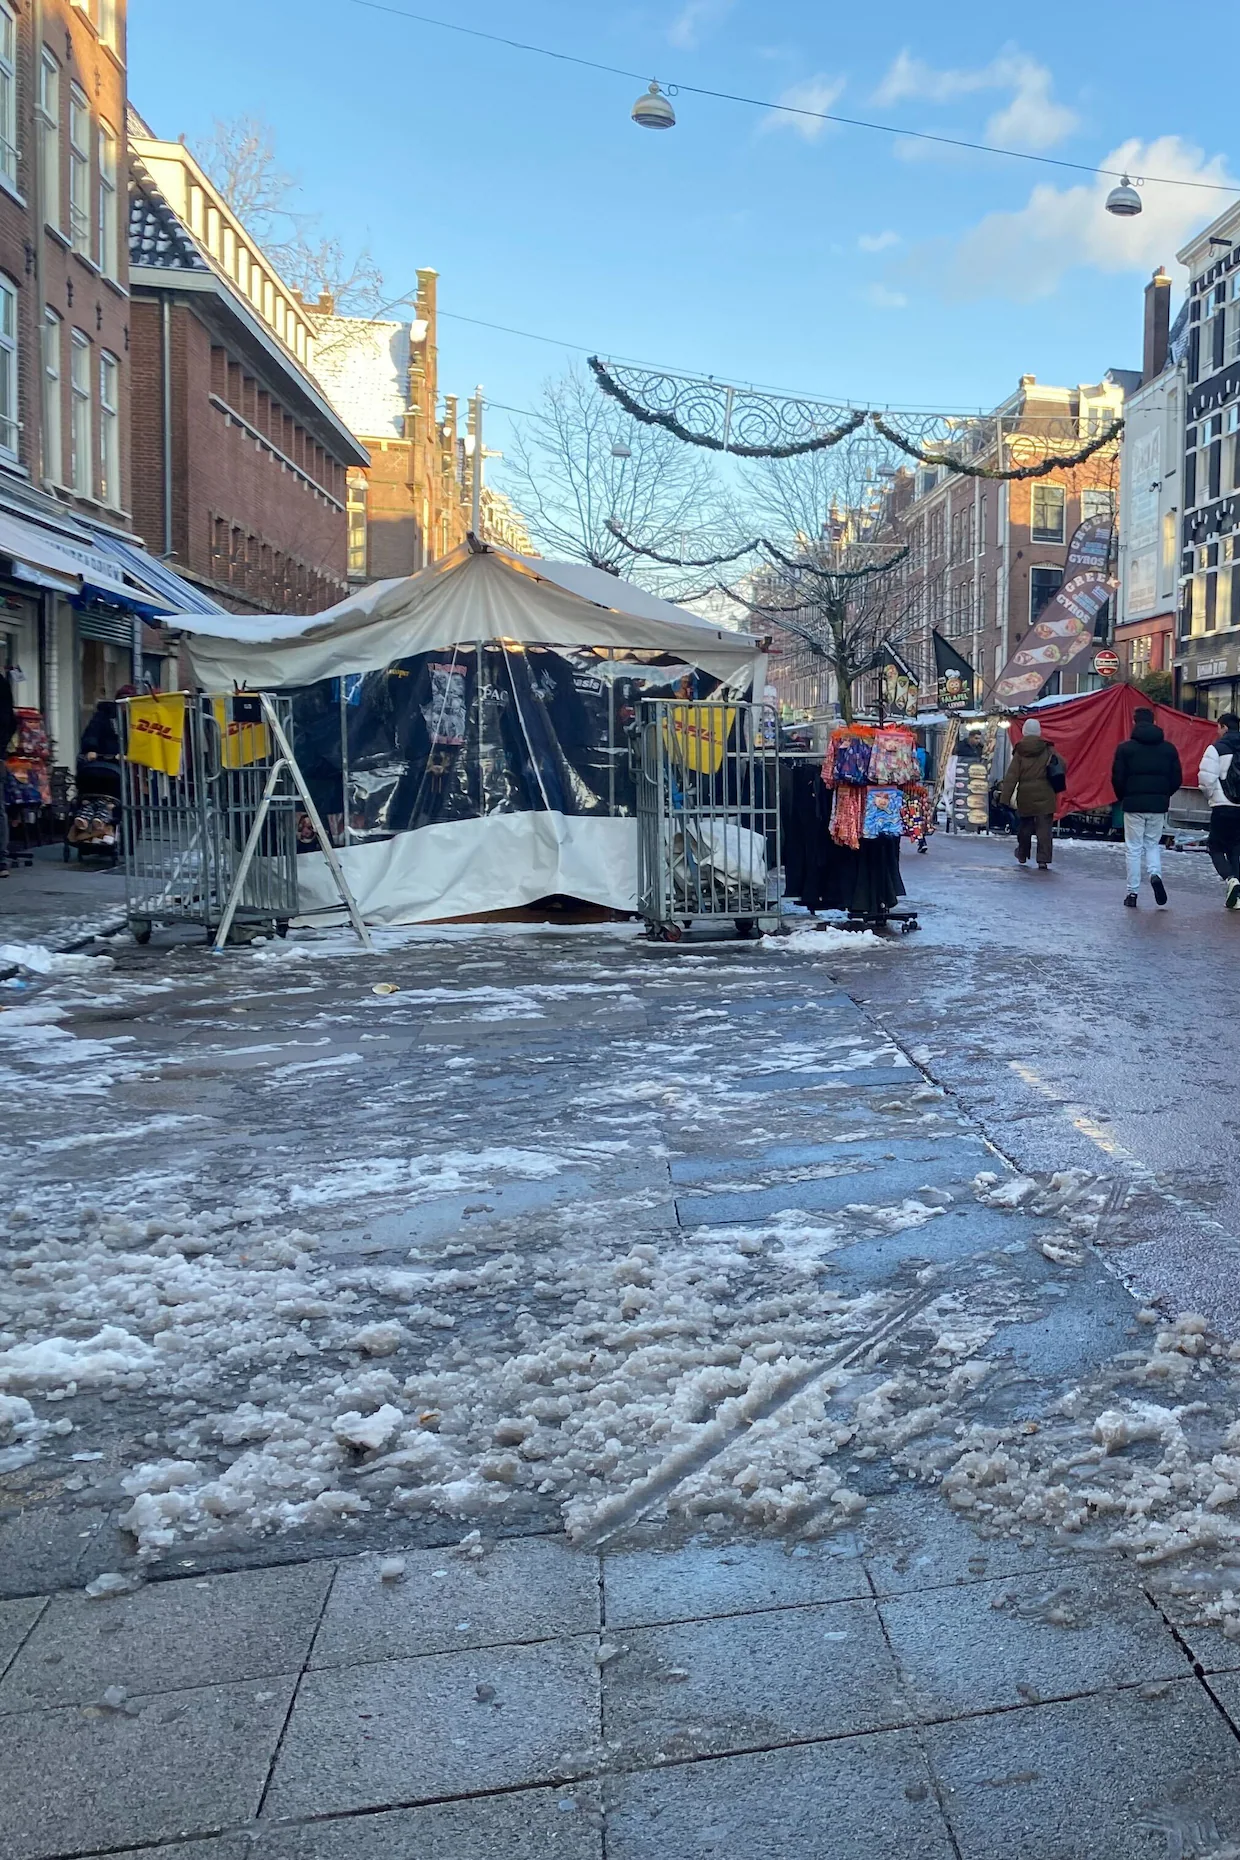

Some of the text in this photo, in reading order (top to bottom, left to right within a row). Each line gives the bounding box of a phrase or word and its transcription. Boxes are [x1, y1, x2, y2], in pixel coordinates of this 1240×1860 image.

[1068, 553, 1105, 567] GYROS
[1064, 572, 1117, 593] GREEK
[1056, 594, 1091, 624] GYROS
[573, 677, 600, 691] asis
[136, 718, 172, 739] DHL
